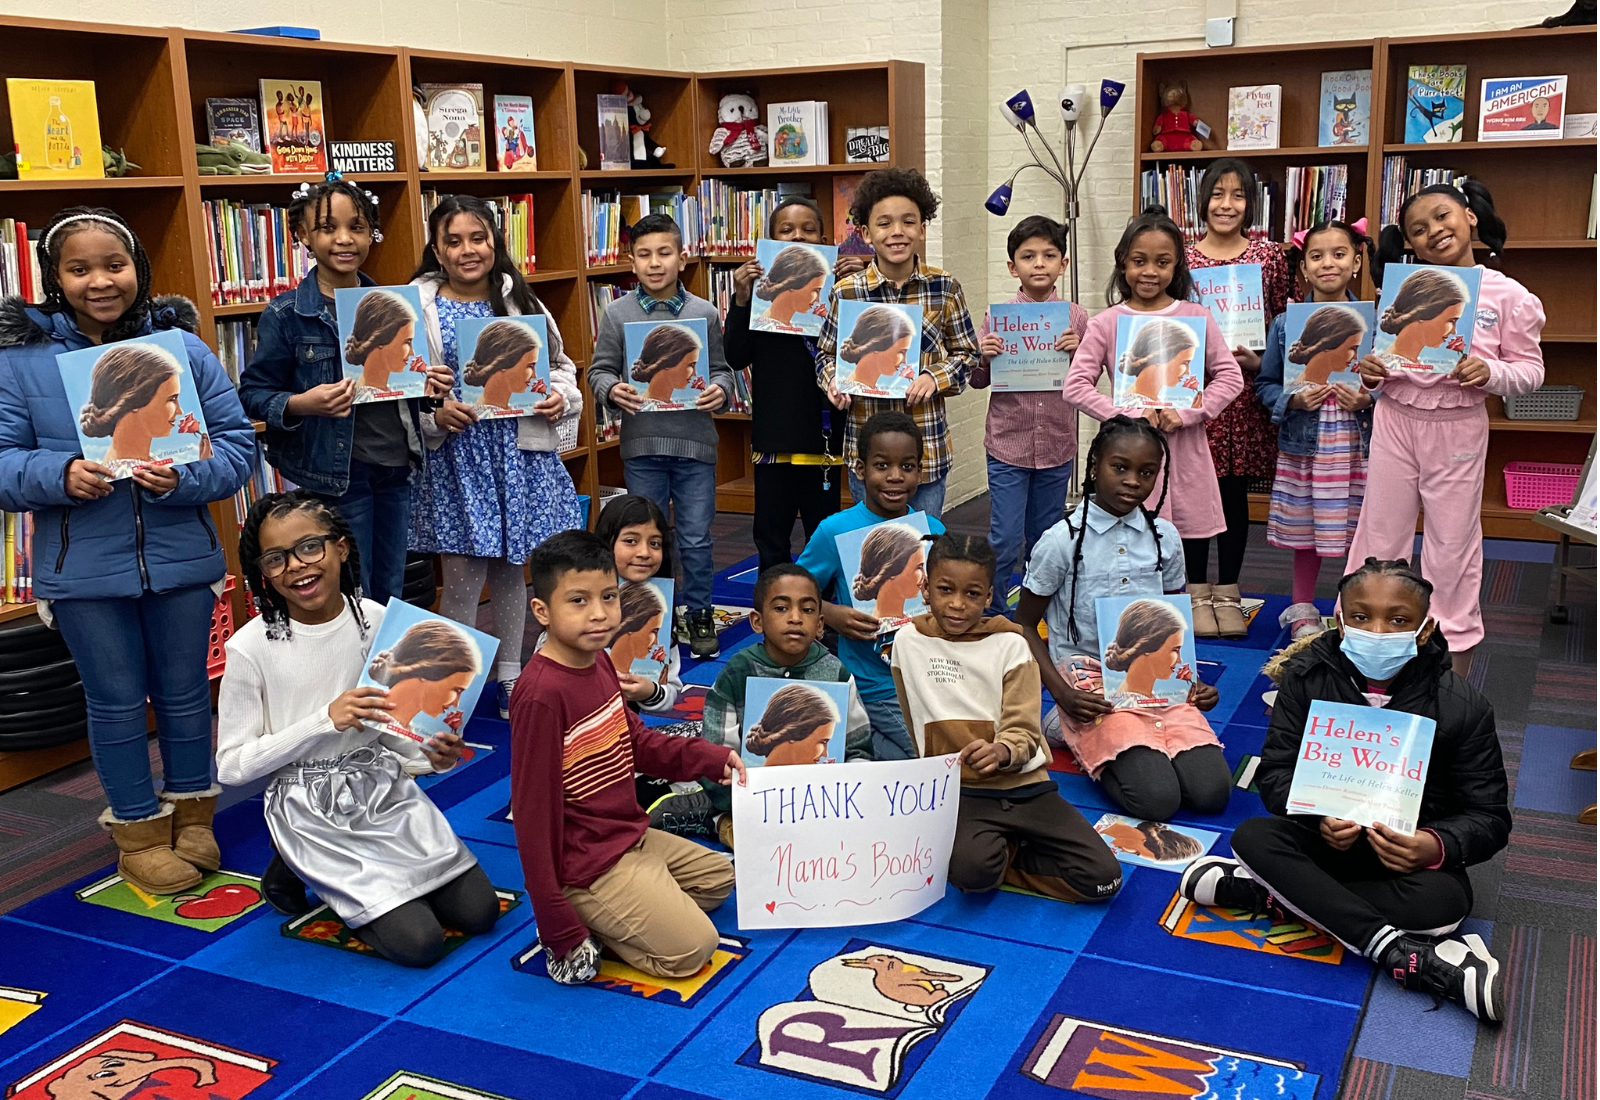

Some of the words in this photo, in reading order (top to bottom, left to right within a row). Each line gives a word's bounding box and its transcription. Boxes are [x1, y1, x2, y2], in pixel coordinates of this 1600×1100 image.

[1412, 69, 1435, 78] These
[1439, 70, 1463, 78] Books
[1246, 91, 1271, 101] Flying
[1332, 84, 1352, 92] Good
[1495, 86, 1508, 96] AM
[1510, 82, 1523, 92] AN
[1257, 100, 1273, 109] Feet
[1487, 82, 1557, 112] AMERICAN
[778, 113, 803, 124] Brother
[779, 106, 787, 116] My
[788, 106, 801, 114] Little
[47, 124, 69, 135] Heart
[331, 143, 393, 157] KINDNESS
[849, 135, 880, 152] DREAM
[872, 143, 889, 156] BIG
[333, 158, 395, 172] MATTERS
[1215, 295, 1261, 313] World
[993, 315, 1051, 332] Helen's
[1021, 335, 1057, 351] Worl
[1308, 716, 1401, 747] Helen's
[1302, 741, 1342, 768] Big
[1351, 746, 1423, 781] World
[1339, 774, 1355, 783] Life
[1356, 777, 1366, 787] of
[1368, 780, 1392, 791] Helen
[1395, 785, 1419, 799] Keller
[753, 782, 864, 824] THANK
[883, 775, 950, 816] YOU!
[770, 840, 857, 898] Nana's
[870, 836, 933, 888] Books
[1097, 882, 1113, 893] New
[1409, 952, 1417, 973] FILA
[769, 1011, 918, 1082] R
[1071, 1031, 1215, 1095] W
